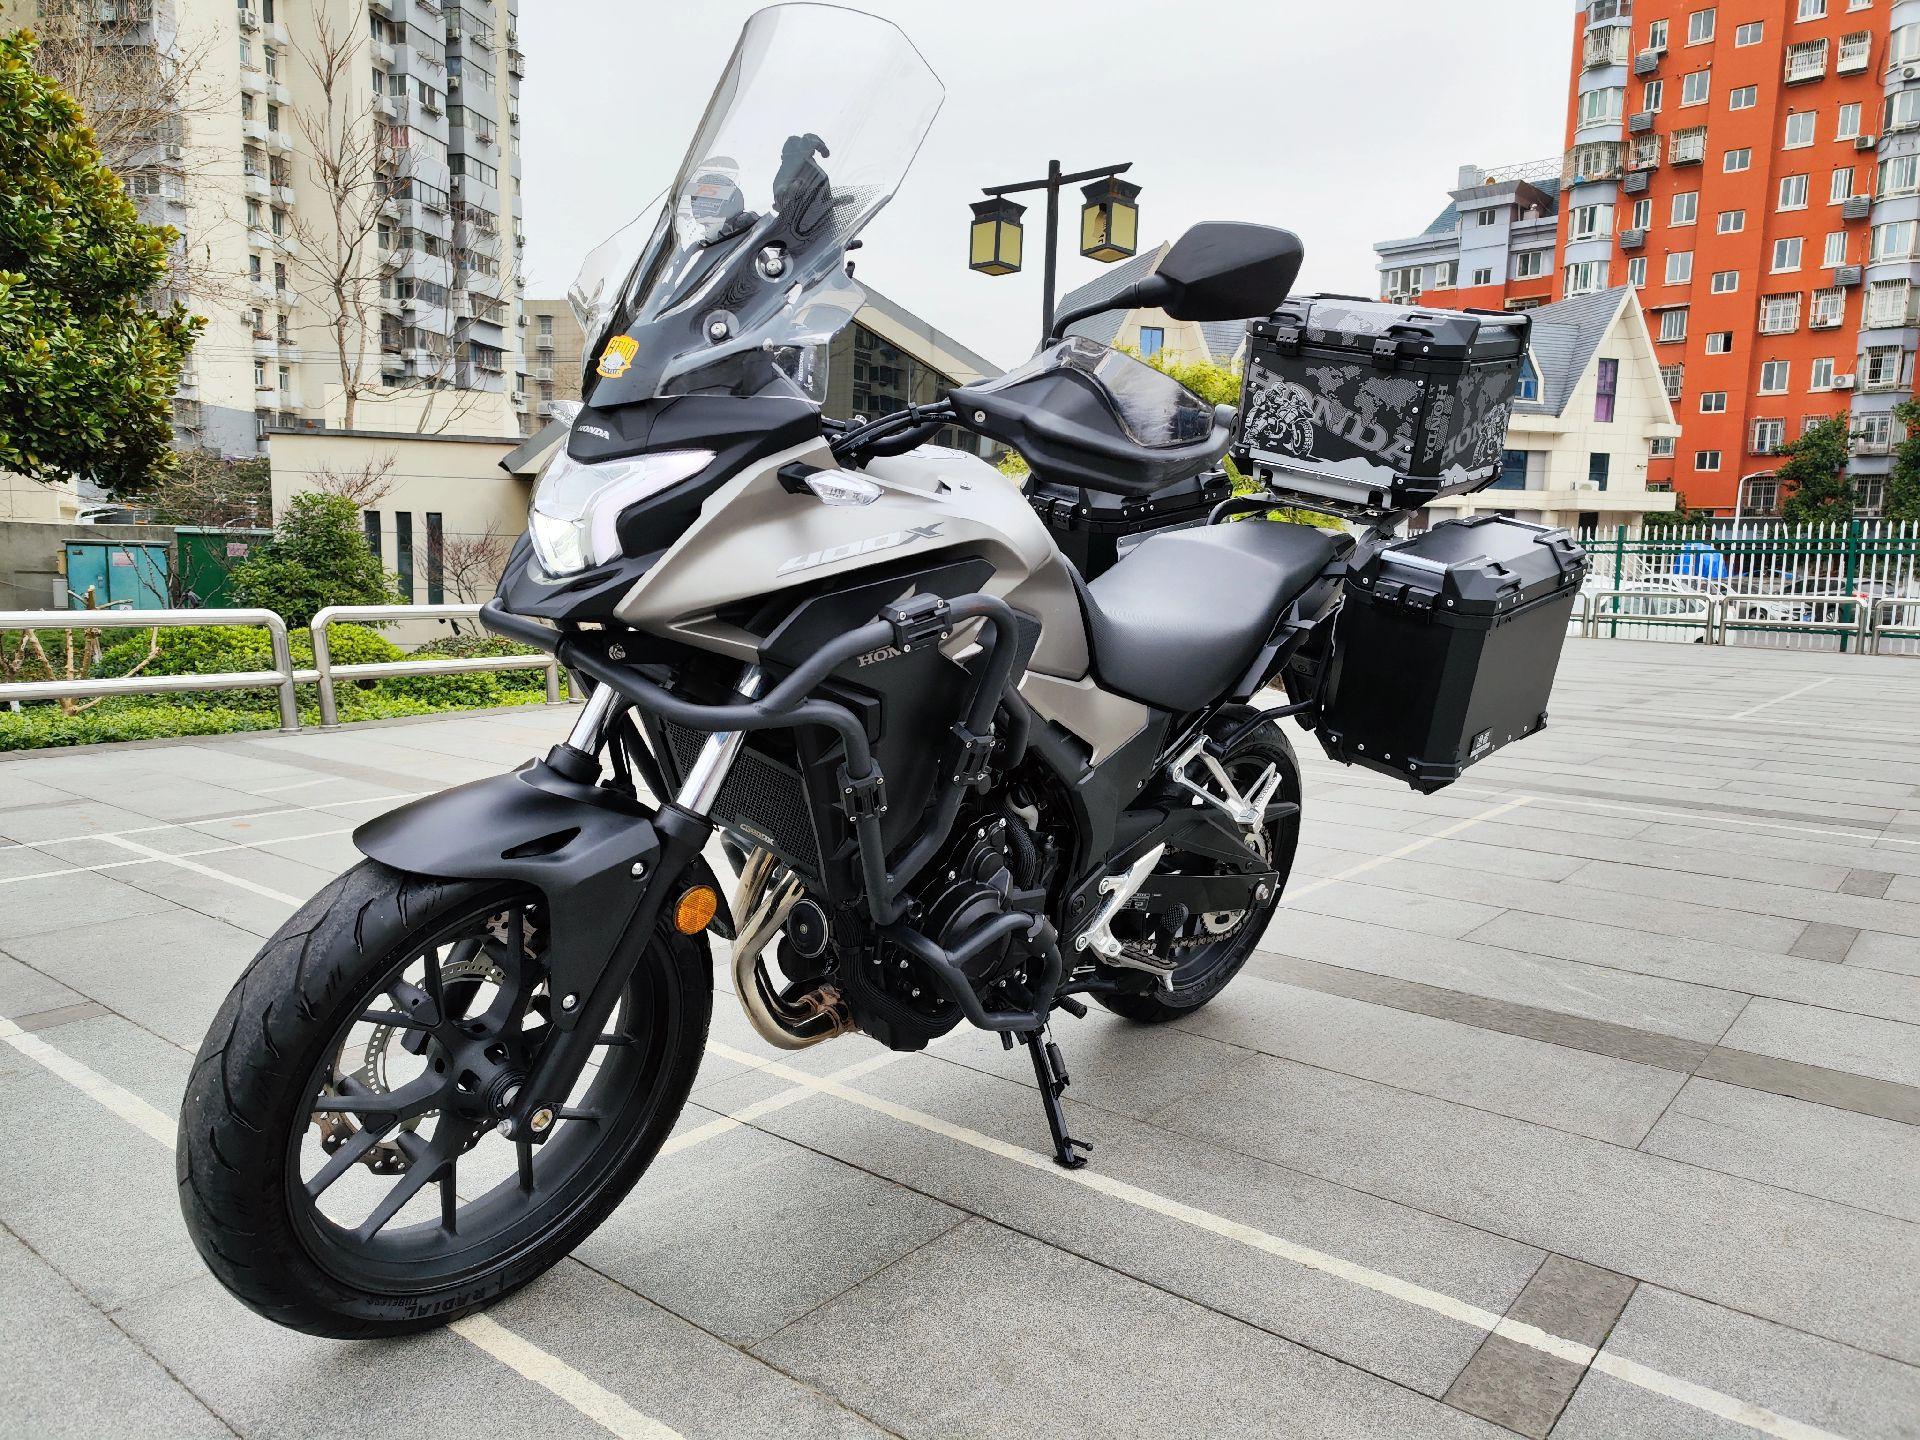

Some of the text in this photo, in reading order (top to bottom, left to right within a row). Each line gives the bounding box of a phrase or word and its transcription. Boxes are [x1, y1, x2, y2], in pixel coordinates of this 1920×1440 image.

[577, 425, 610, 440] HONDA
[1422, 384, 1449, 463] HONDA
[405, 1287, 486, 1318] RADIAL
